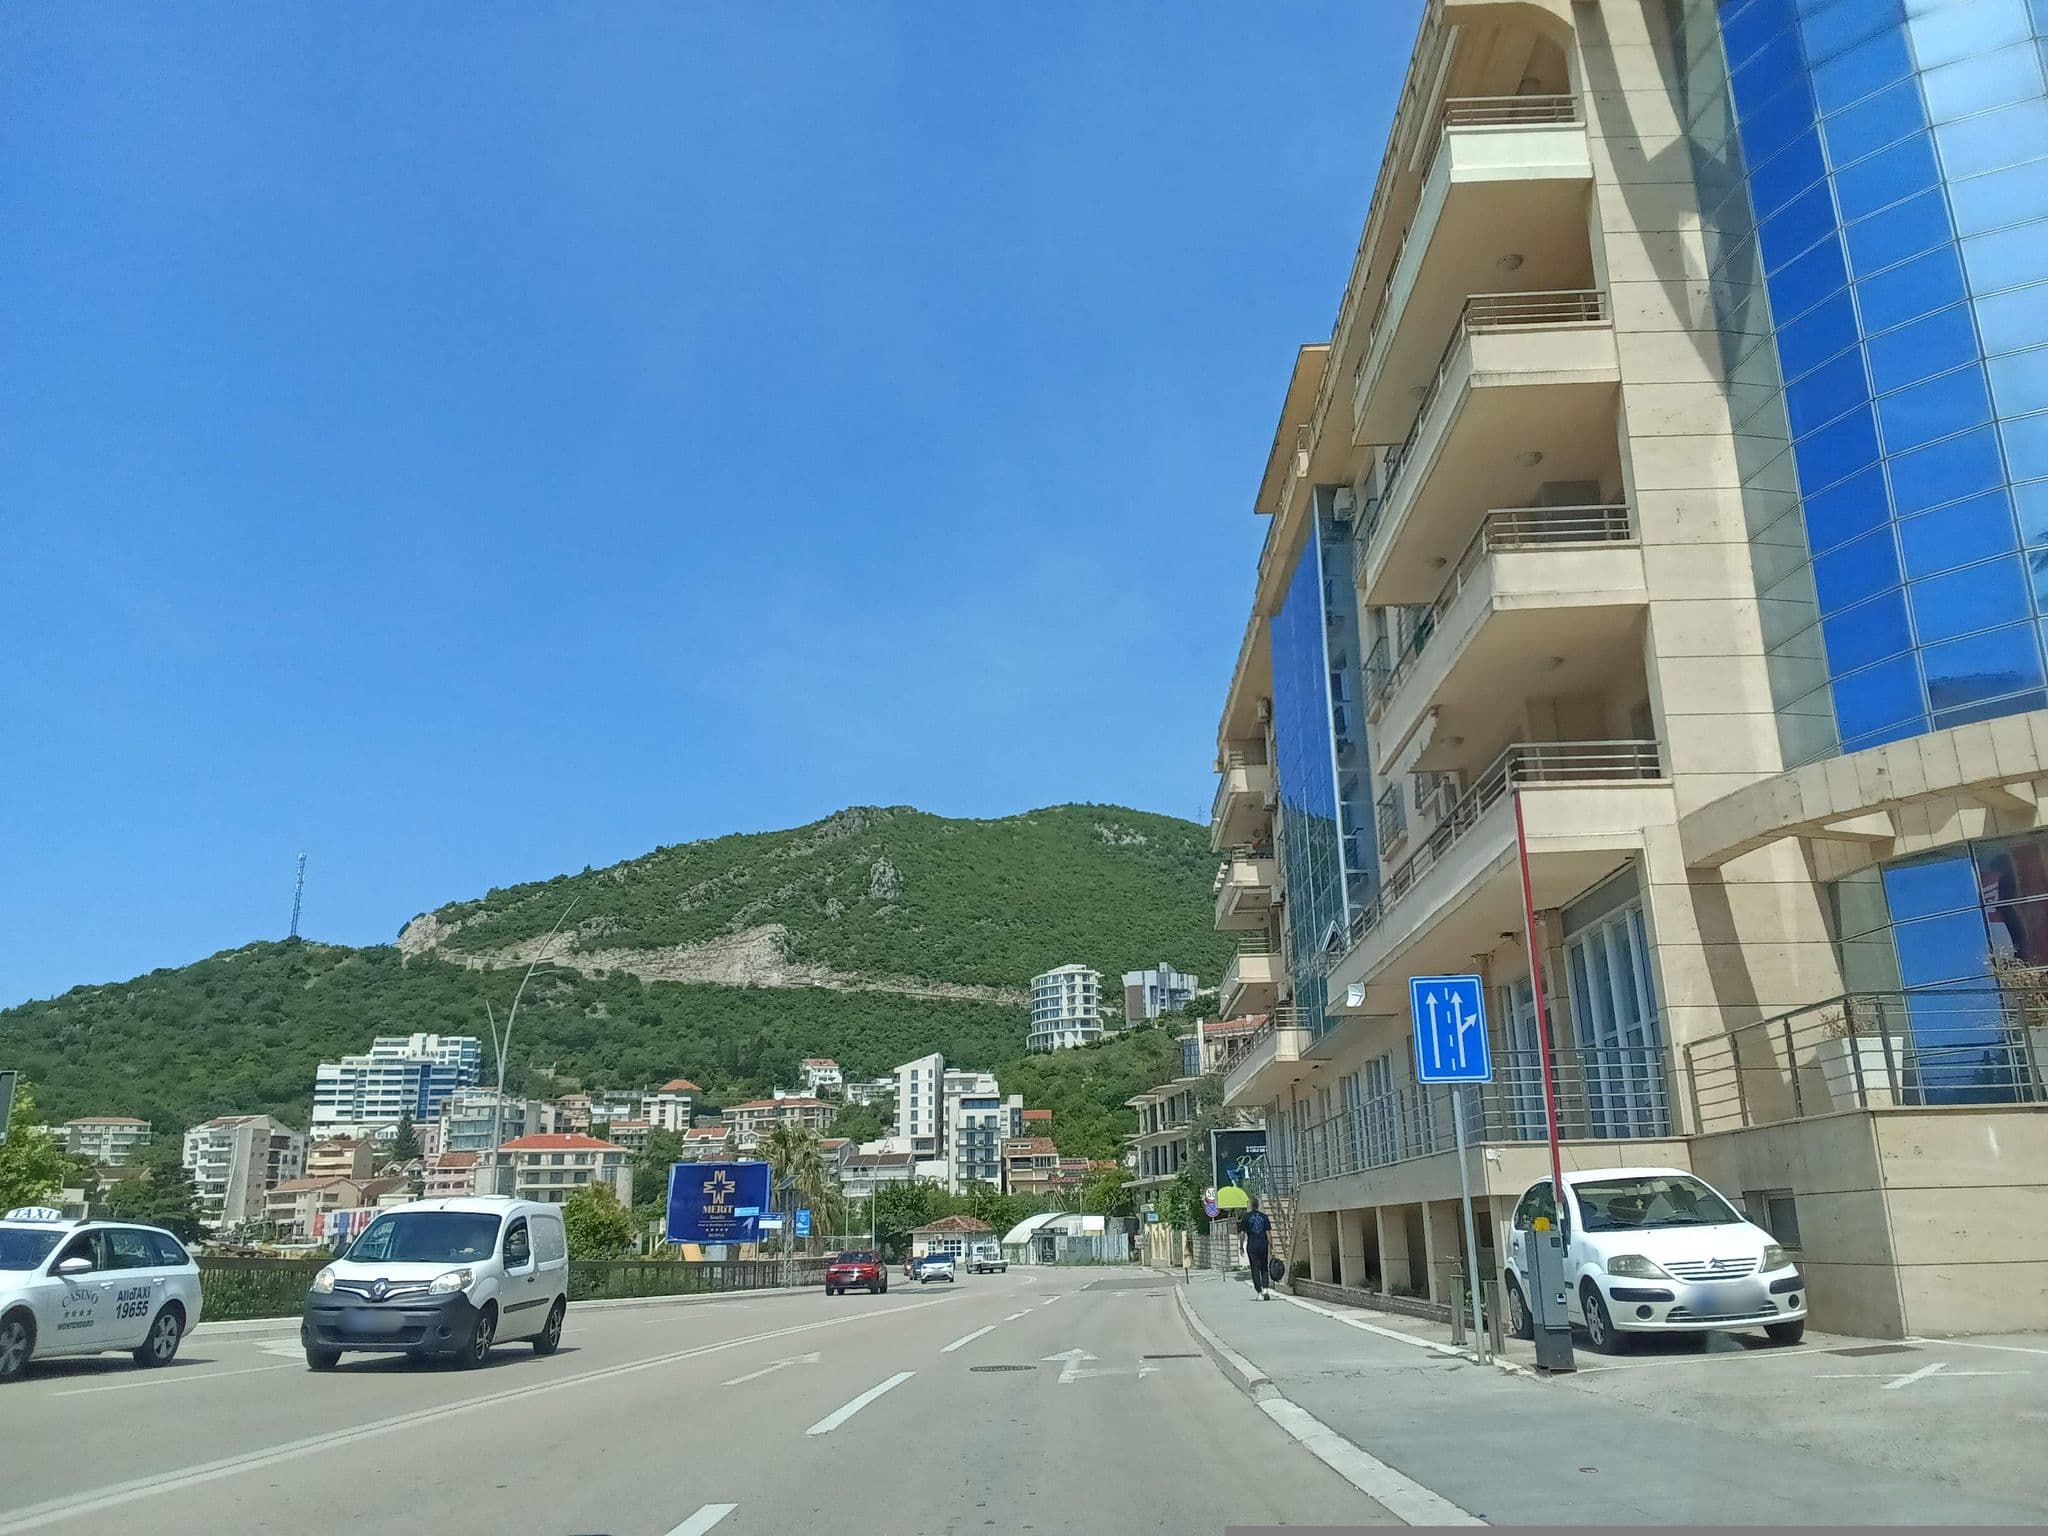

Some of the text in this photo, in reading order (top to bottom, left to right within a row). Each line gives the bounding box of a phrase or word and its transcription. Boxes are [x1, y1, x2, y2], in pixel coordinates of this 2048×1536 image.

[13, 1208, 53, 1219] TAXI
[703, 1205, 734, 1214] MERIT
[62, 1289, 98, 1308] CASINO
[116, 1301, 149, 1319] 19655
